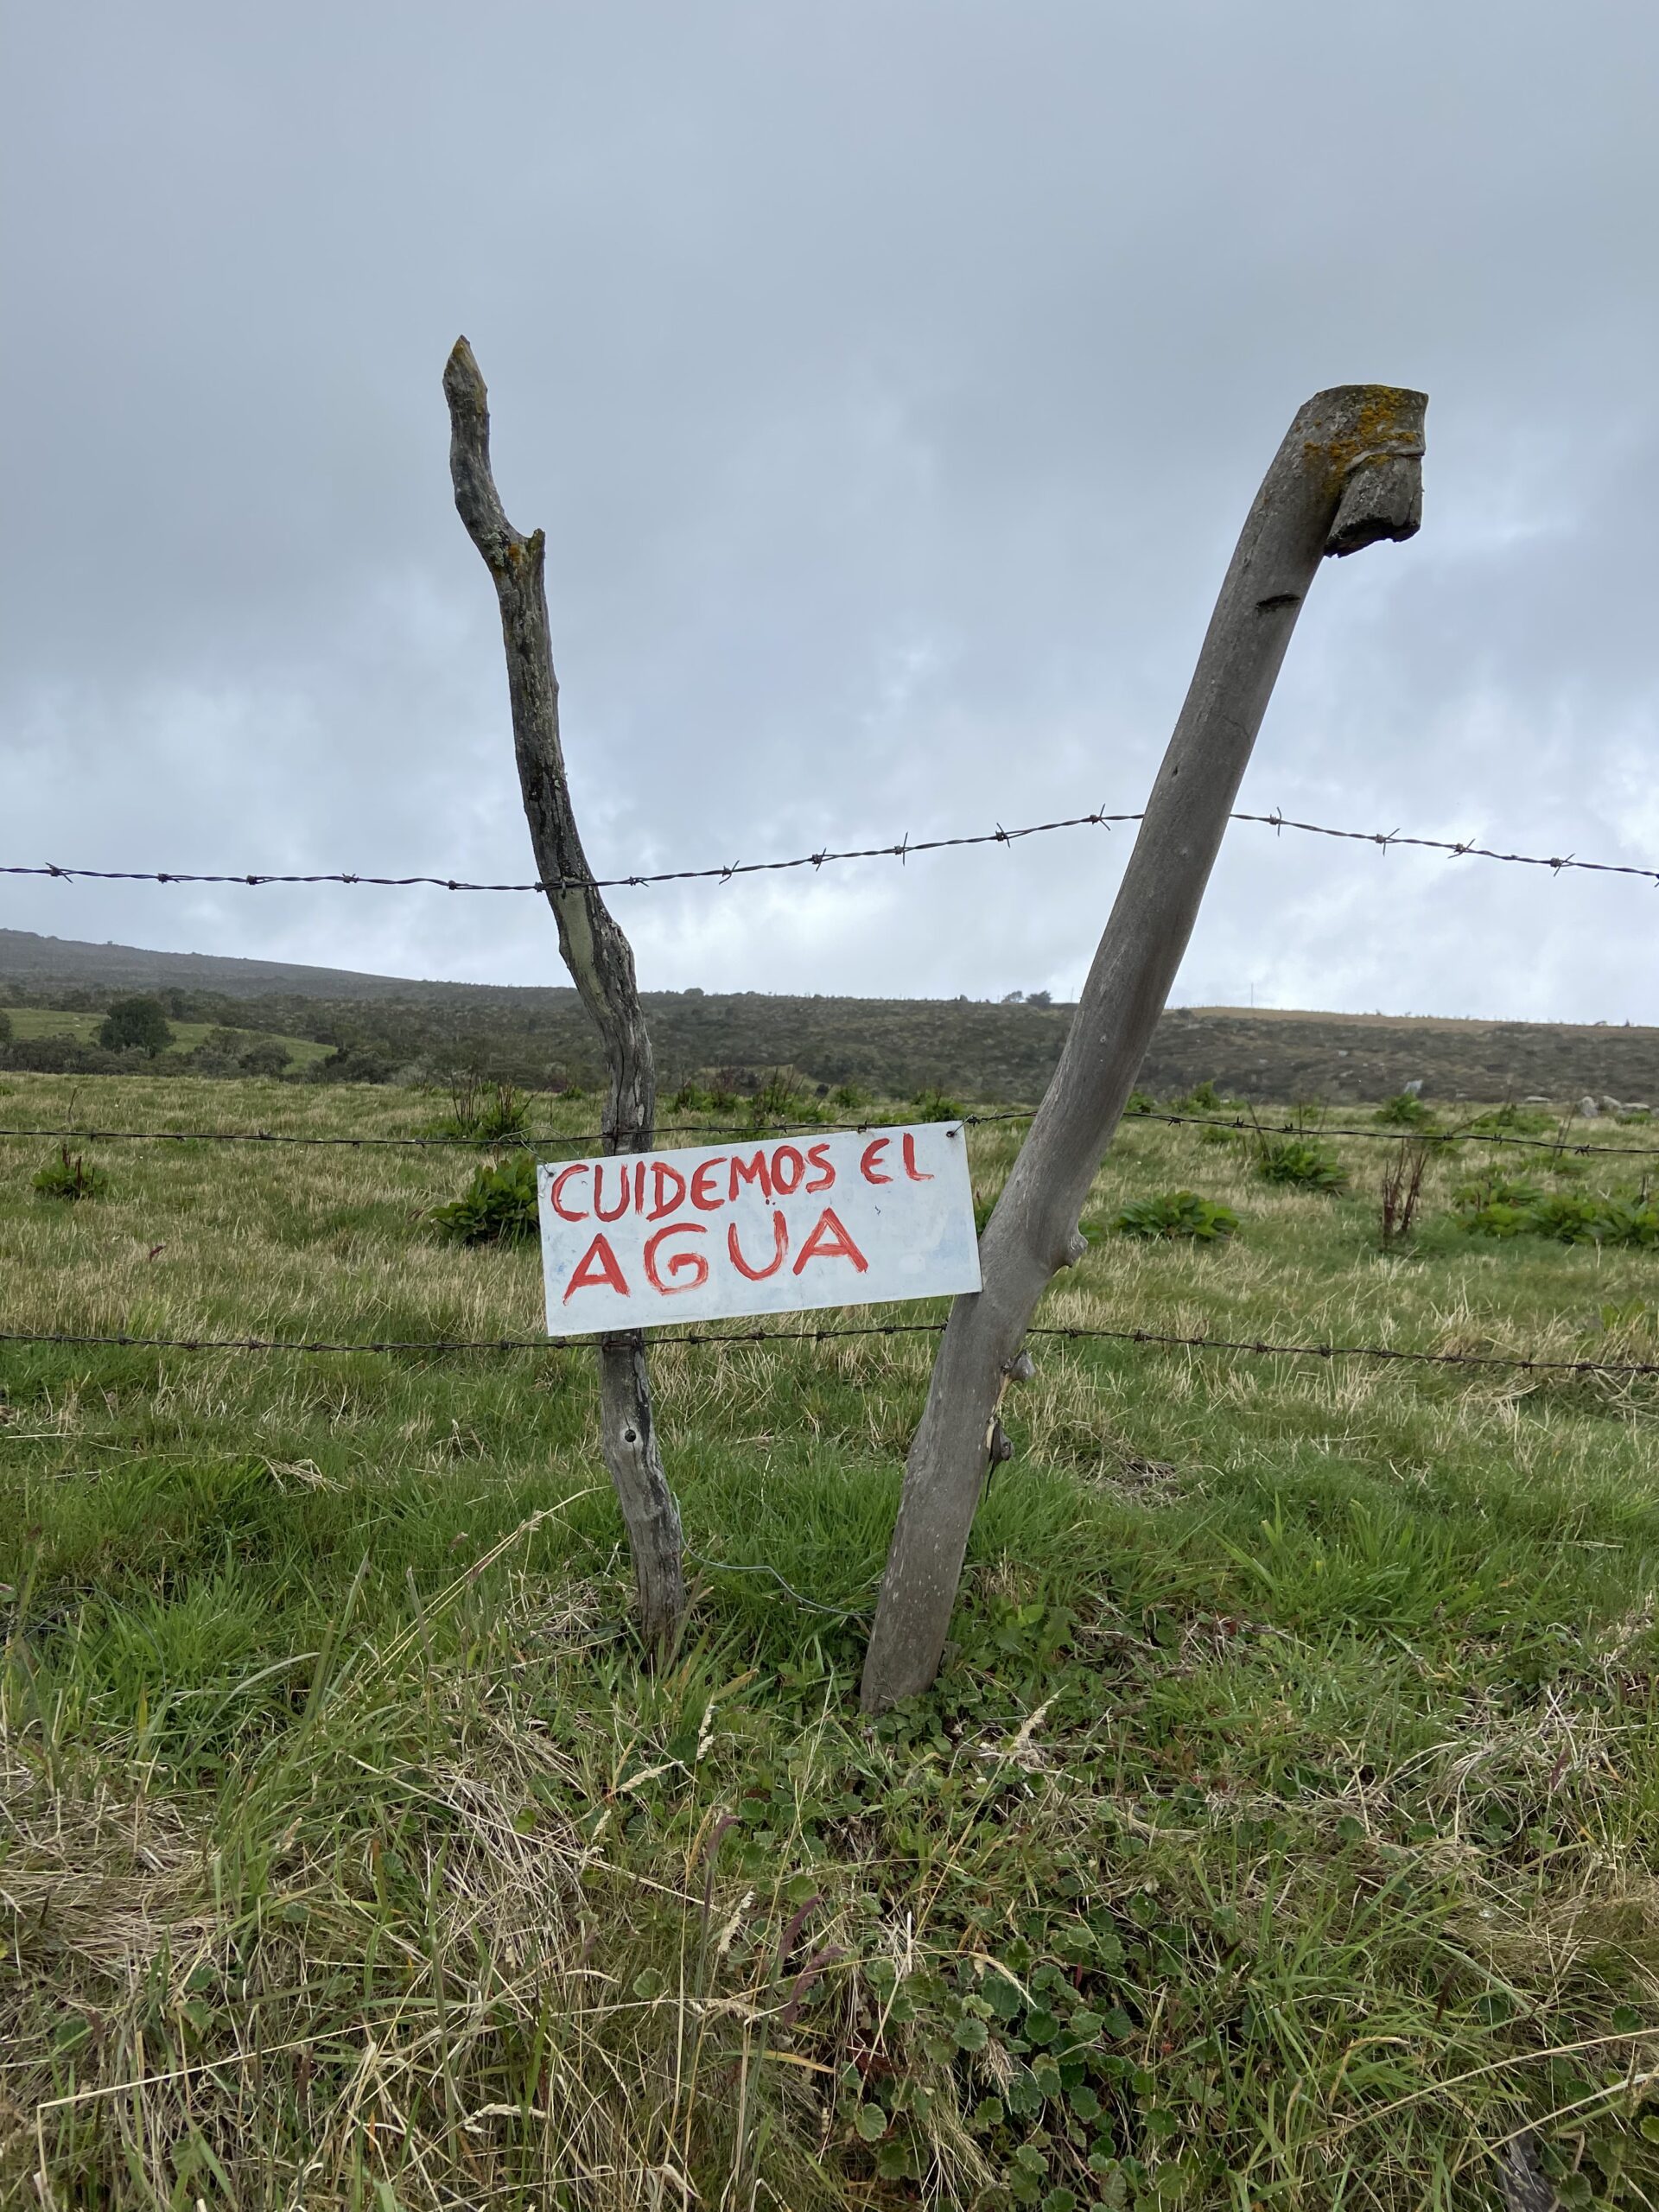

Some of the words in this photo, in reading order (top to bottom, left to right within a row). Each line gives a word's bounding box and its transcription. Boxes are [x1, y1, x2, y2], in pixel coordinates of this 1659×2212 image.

[550, 1143, 836, 1224] CUIDEMOS
[860, 1133, 935, 1185] EL
[563, 1207, 869, 1306] AGUA
